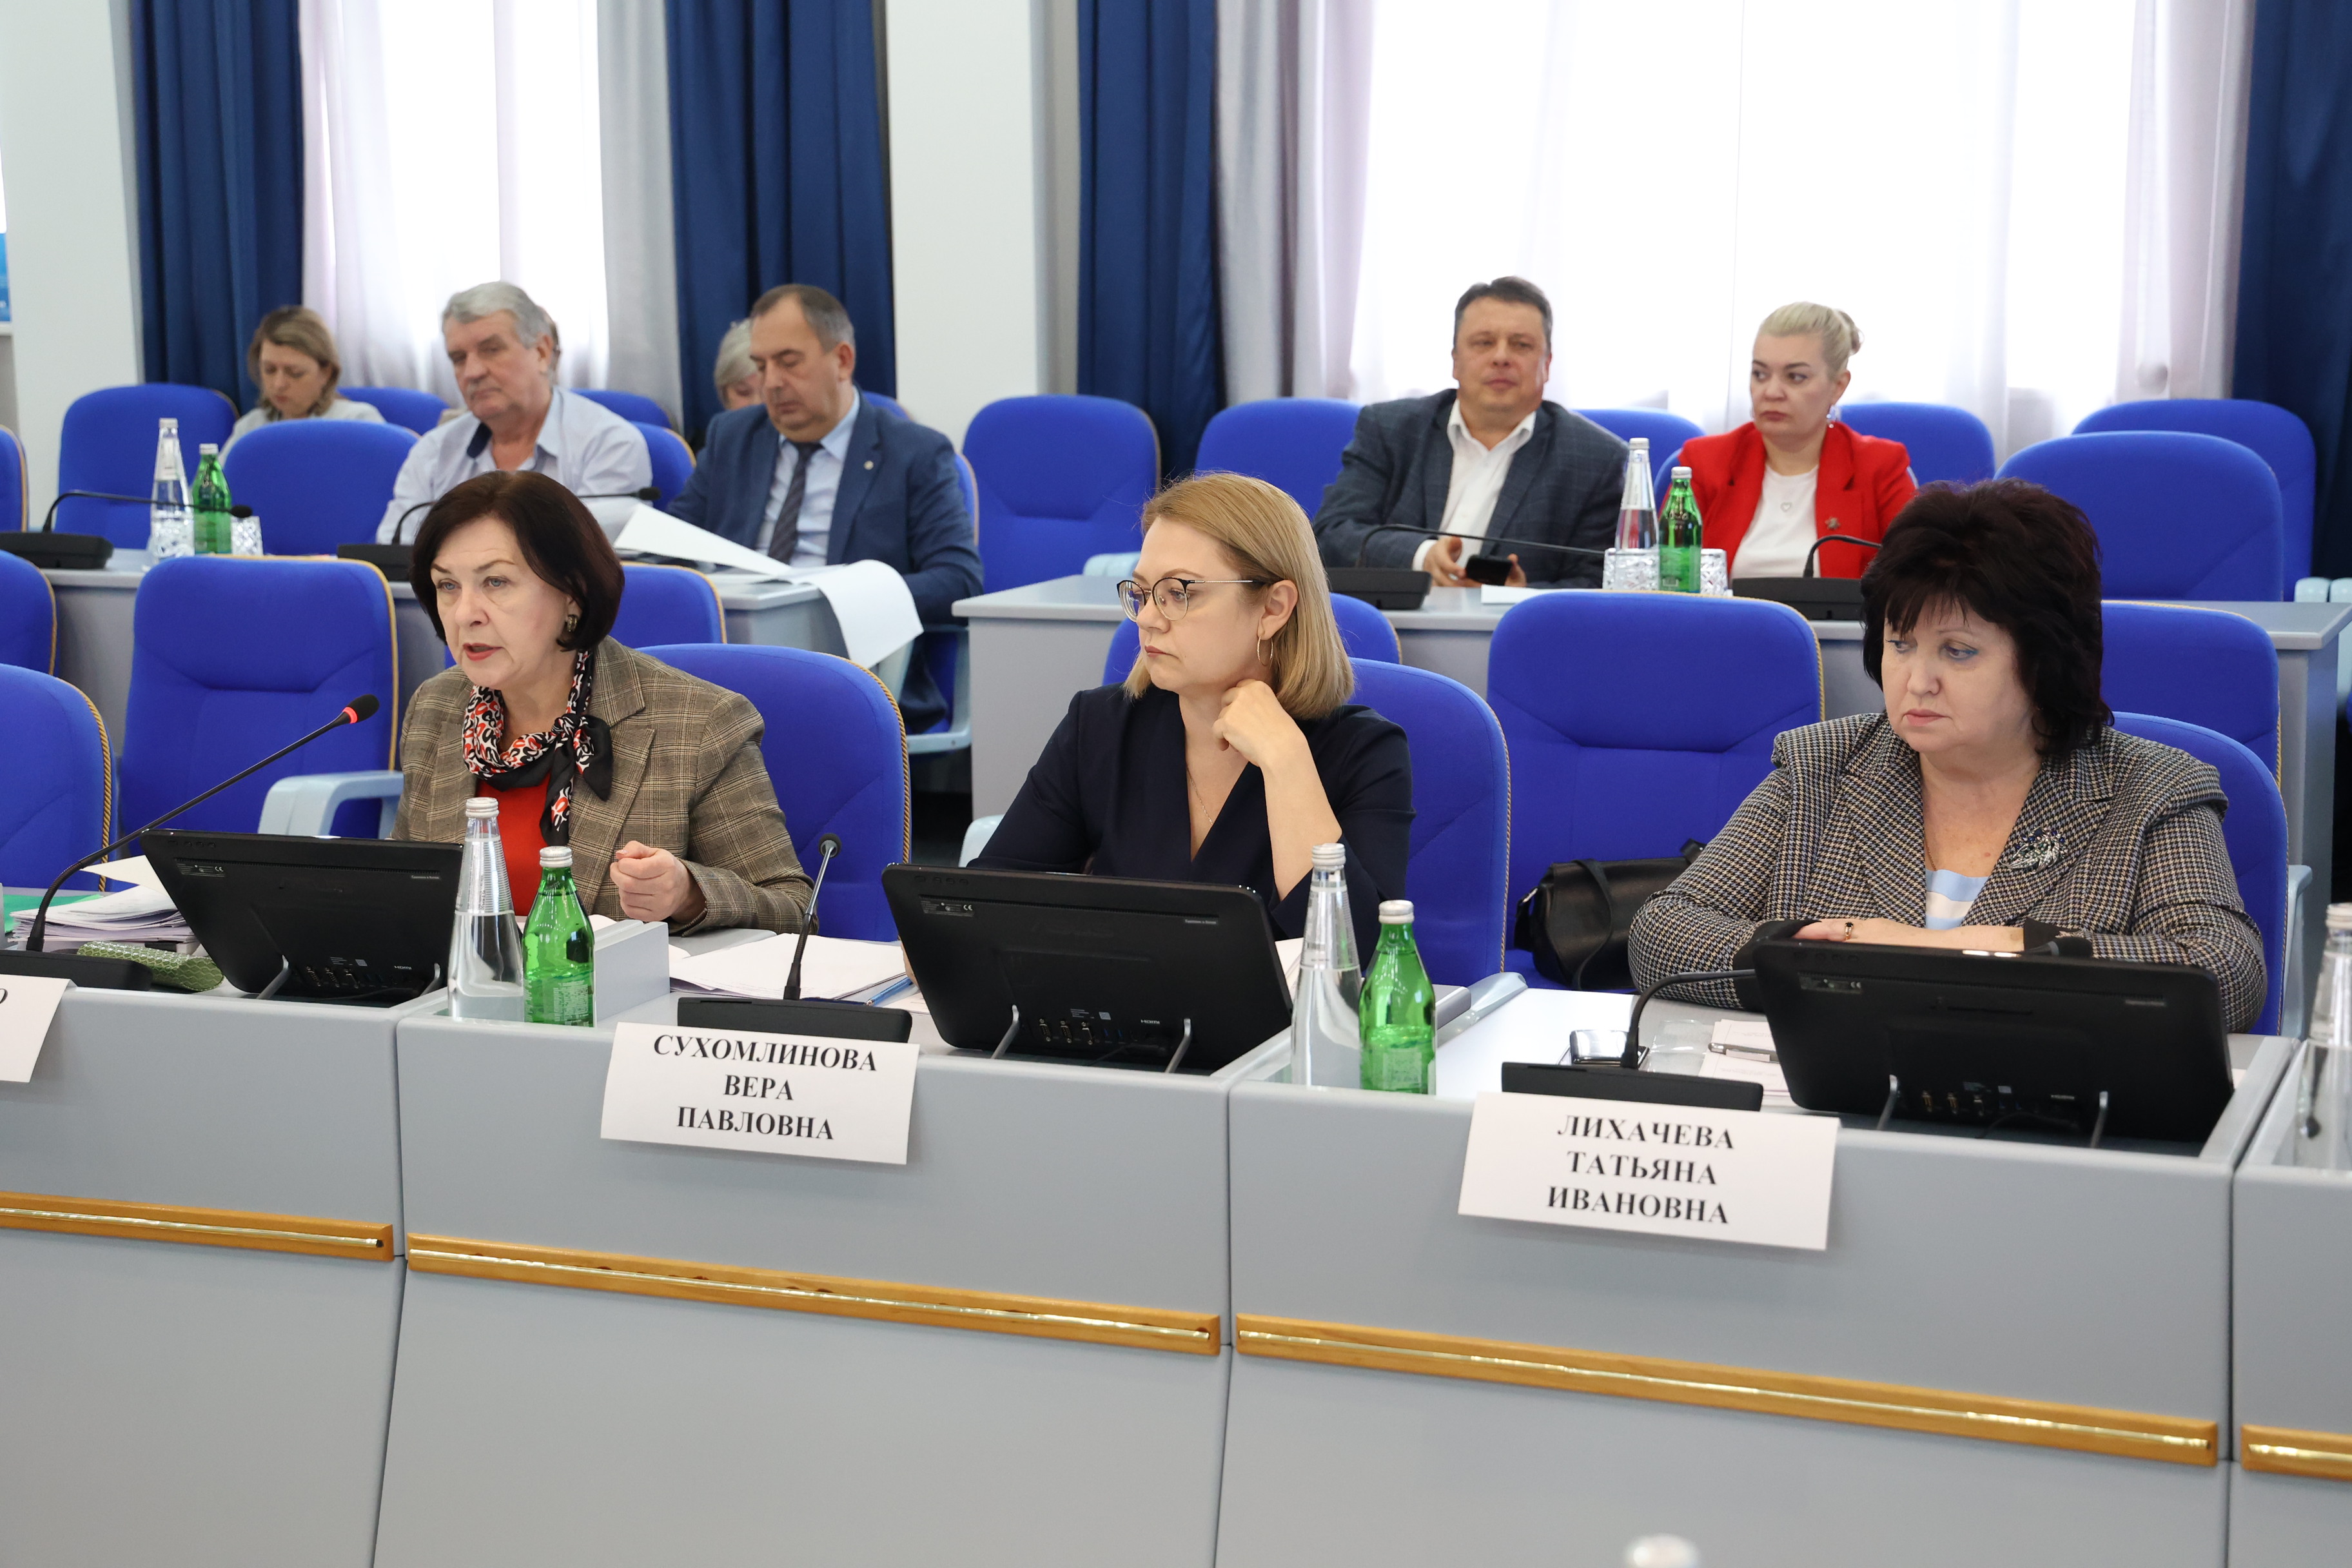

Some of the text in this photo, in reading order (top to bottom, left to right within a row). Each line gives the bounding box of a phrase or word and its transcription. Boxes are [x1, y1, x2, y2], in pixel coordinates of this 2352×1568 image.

[654, 1034, 877, 1071] СУХОМЛИНОВА
[723, 1075, 794, 1101] ВЕРА
[677, 1106, 834, 1140] ПАВЛОВНА
[1558, 1115, 1734, 1149] ЛИХАЧЕВА
[1567, 1152, 1717, 1185] ТАТЬЯНА
[1547, 1186, 1729, 1224] ИВАНОВНА
